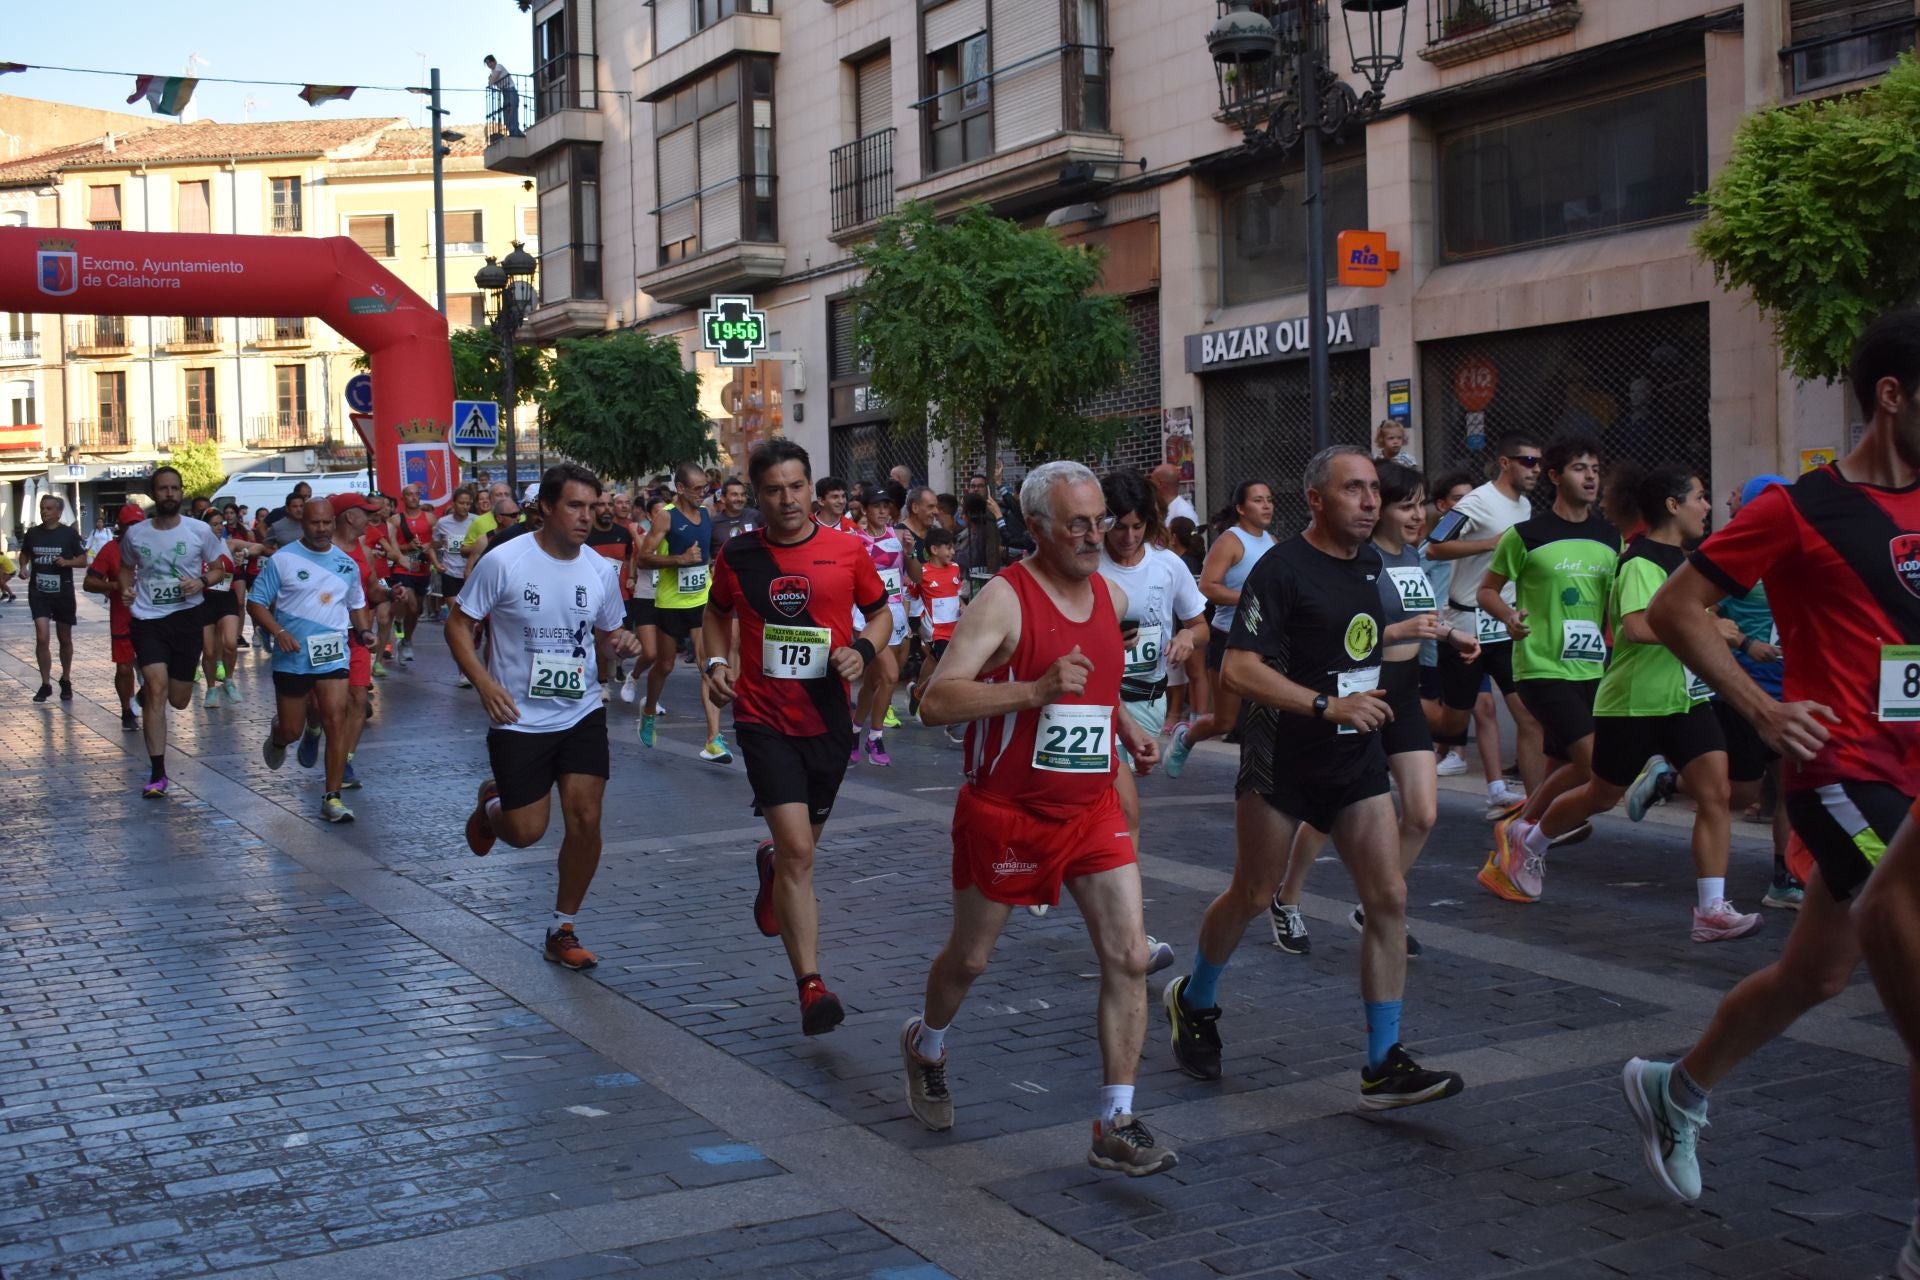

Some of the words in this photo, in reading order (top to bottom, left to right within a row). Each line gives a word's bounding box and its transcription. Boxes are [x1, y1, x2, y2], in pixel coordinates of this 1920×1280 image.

[1350, 245, 1379, 265] Ria
[82, 256, 138, 272] Excmo.
[142, 258, 244, 275] Ayuntamiento
[82, 275, 102, 287] de
[106, 274, 181, 288] Calahorra
[711, 322, 758, 339] 19:56
[1202, 326, 1270, 364] BAZAR
[1275, 312, 1353, 353] OUDA
[109, 464, 143, 479] BEBE
[1554, 557, 1582, 571] chef
[38, 578, 58, 588] 229
[682, 573, 706, 586] 185
[153, 586, 182, 600] 249
[773, 592, 806, 601] LODOSA
[1400, 579, 1429, 598] 221
[539, 627, 575, 639] SILVESTRE
[765, 633, 784, 641] CIUDAD
[312, 641, 341, 658] 231
[1568, 633, 1602, 651] 274
[779, 644, 811, 666] 173
[537, 668, 581, 690] 208
[1043, 725, 1104, 754] 227
